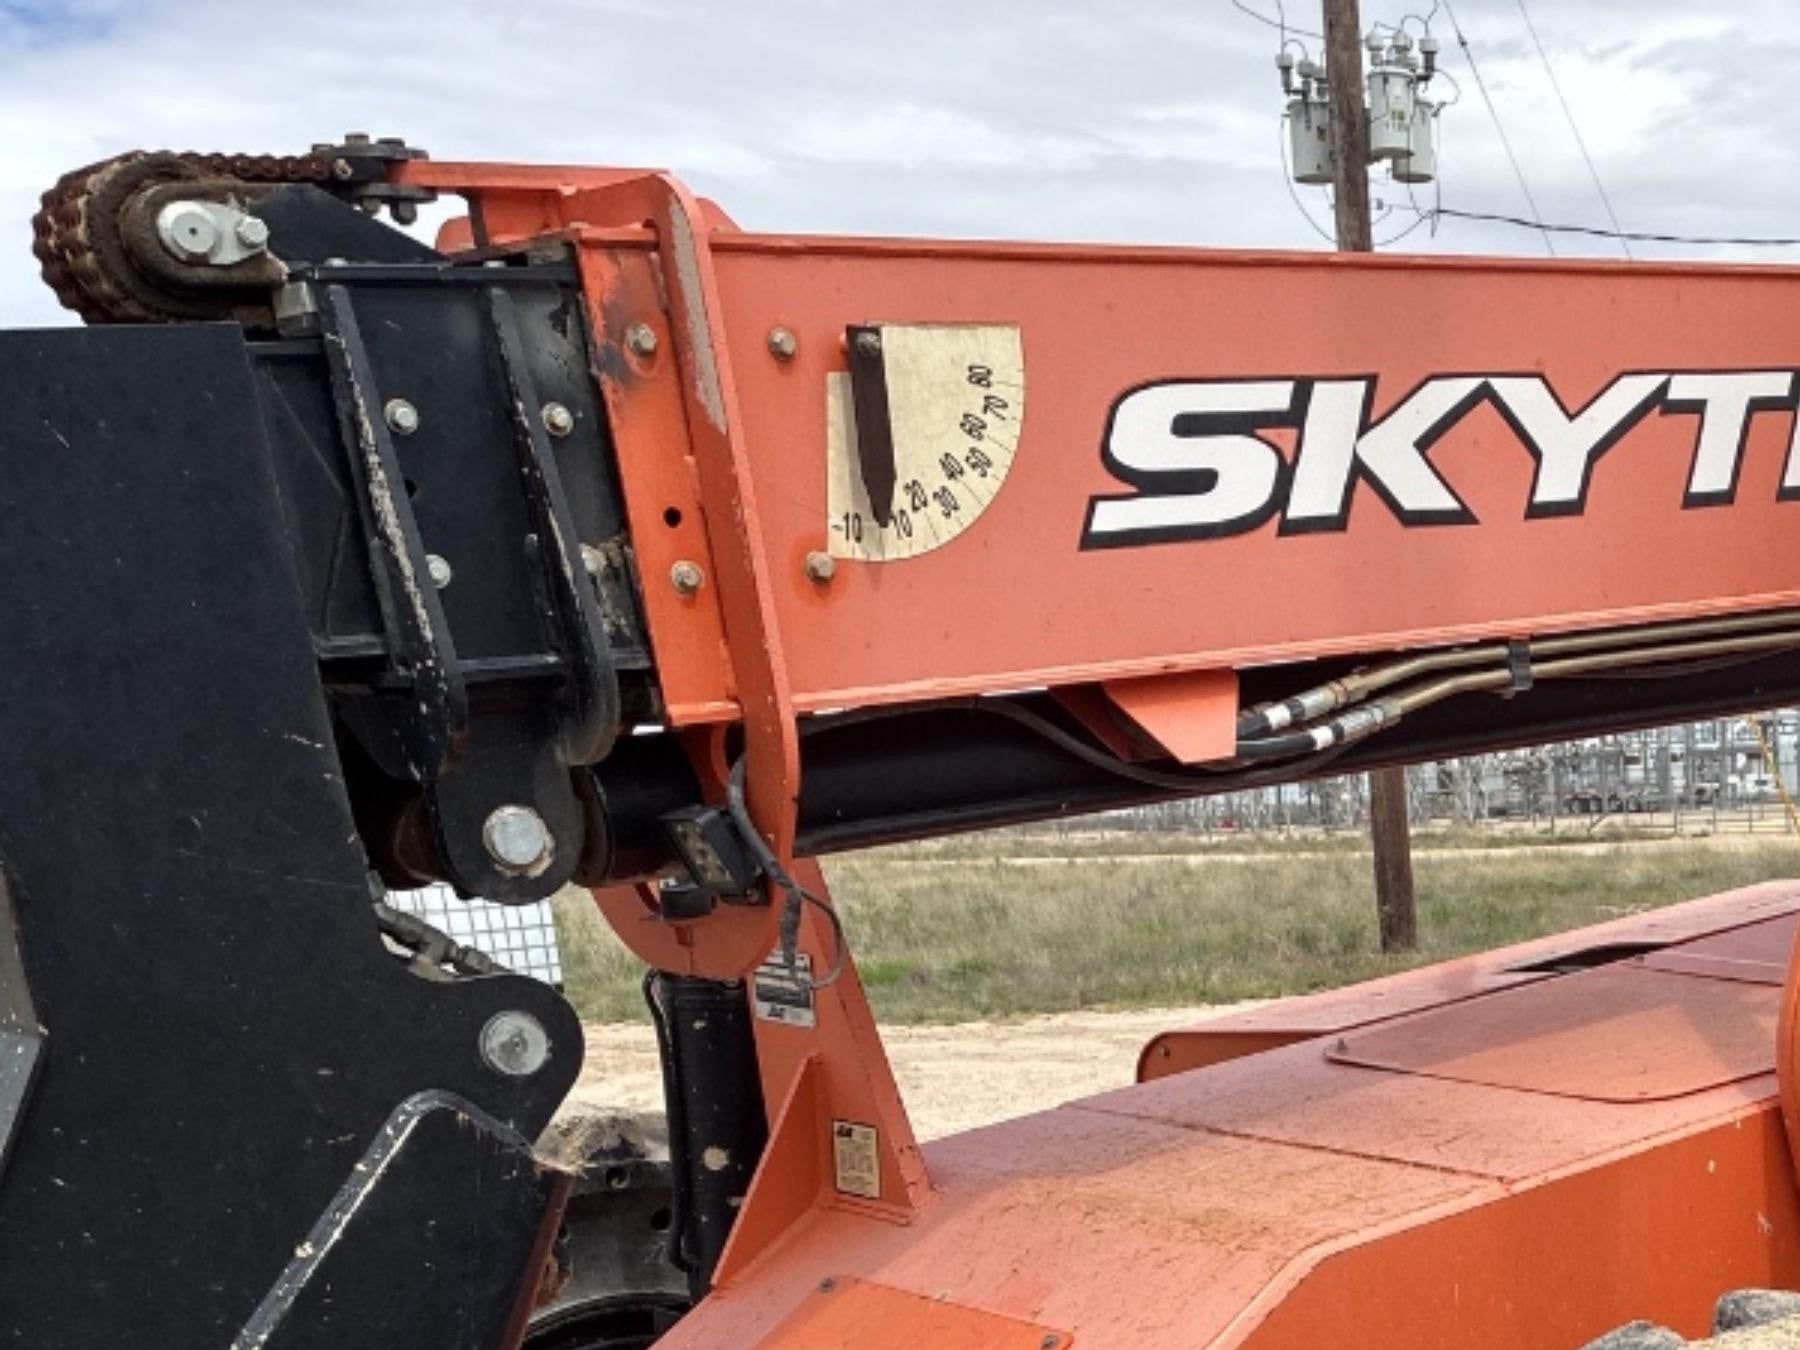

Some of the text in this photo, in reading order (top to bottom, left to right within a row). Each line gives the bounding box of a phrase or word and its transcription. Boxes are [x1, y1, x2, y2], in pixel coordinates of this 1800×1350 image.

[967, 364, 993, 388] 80
[983, 394, 1009, 421] 70
[959, 412, 988, 441] 60
[938, 451, 966, 481] 40
[965, 446, 992, 478] 50
[903, 478, 928, 513] 20
[932, 485, 960, 519] 30
